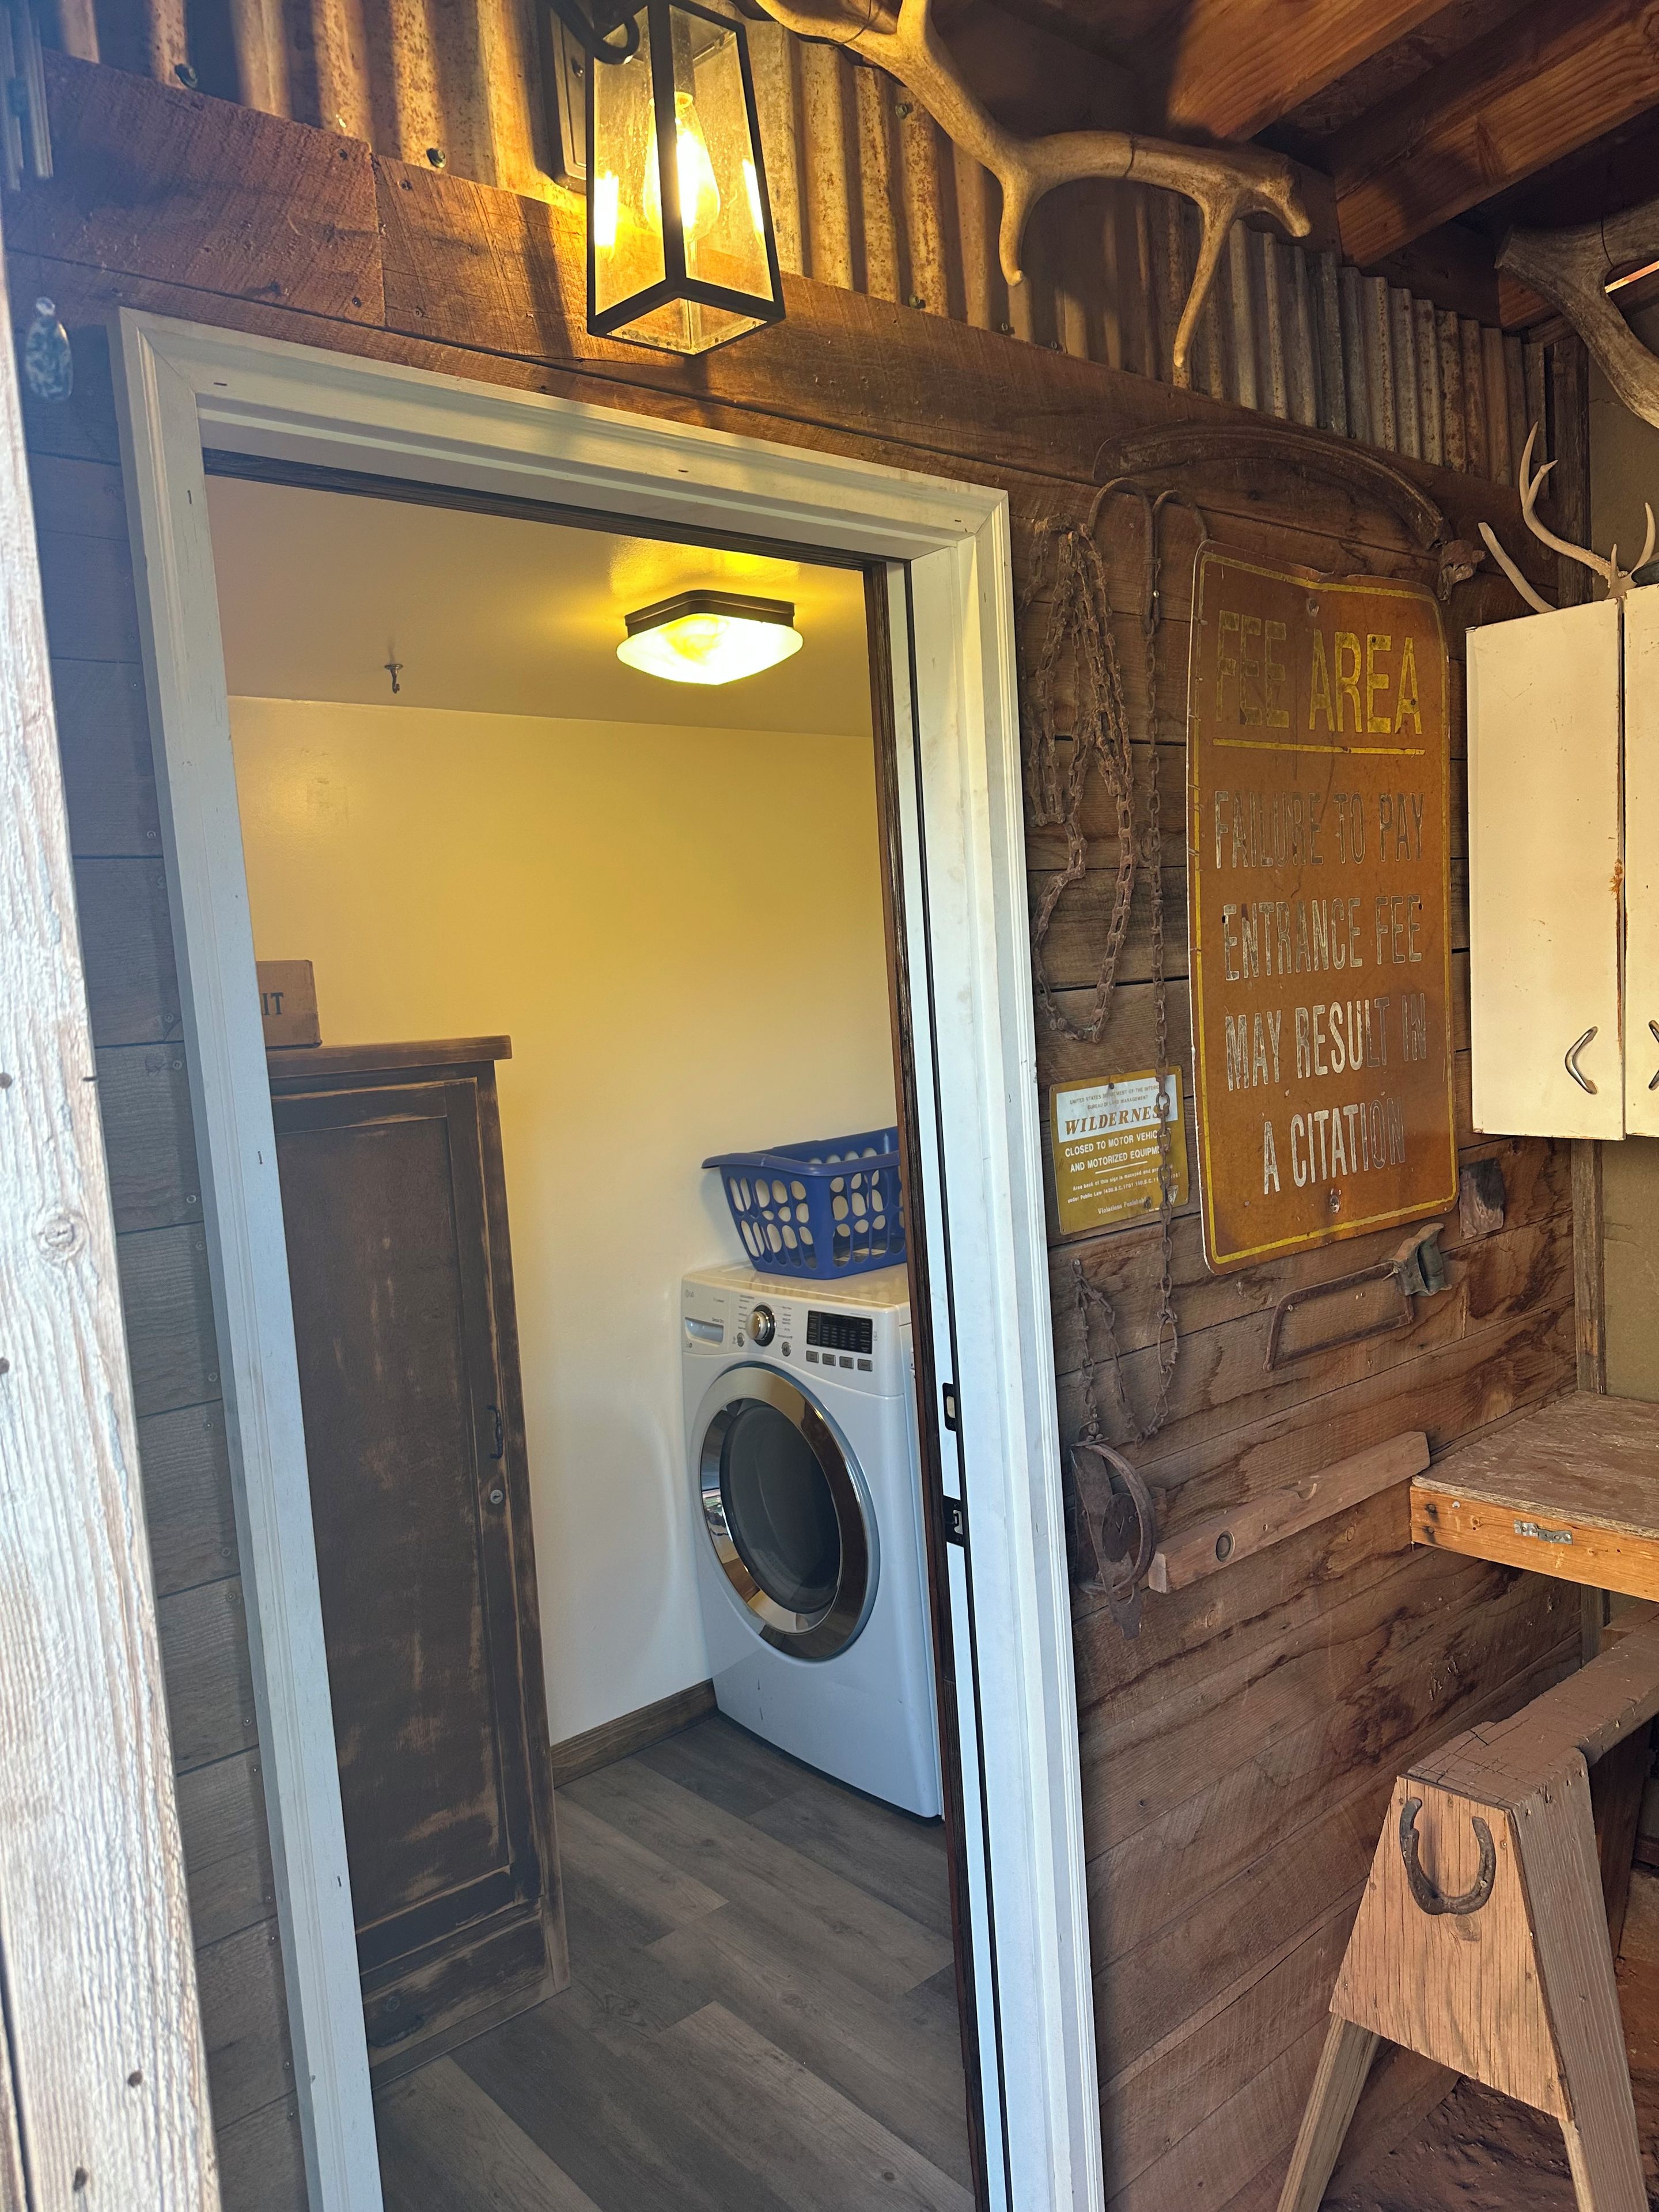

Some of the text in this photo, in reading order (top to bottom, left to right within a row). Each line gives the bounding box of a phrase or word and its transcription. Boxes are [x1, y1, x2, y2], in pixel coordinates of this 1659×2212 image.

[1215, 610, 1423, 735] FEE AREA
[1214, 790, 1425, 870] FAILURE TO PAY
[1222, 893, 1423, 982] ENTRANCE FEE
[262, 992, 284, 1016] IT
[1225, 993, 1427, 1092] MAY RESULT IN
[1086, 1094, 1101, 1102] STATES
[1120, 1095, 1148, 1104] MANAGEMENT
[1065, 1143, 1094, 1157] CLOSED
[1096, 1141, 1106, 1150] TO
[1108, 1135, 1134, 1147] MOTOR
[1263, 1097, 1406, 1195] A CITATION
[1070, 1162, 1085, 1173] AND
[1088, 1153, 1128, 1169] MOTORIZED
[1097, 1203, 1122, 1214] Violations
